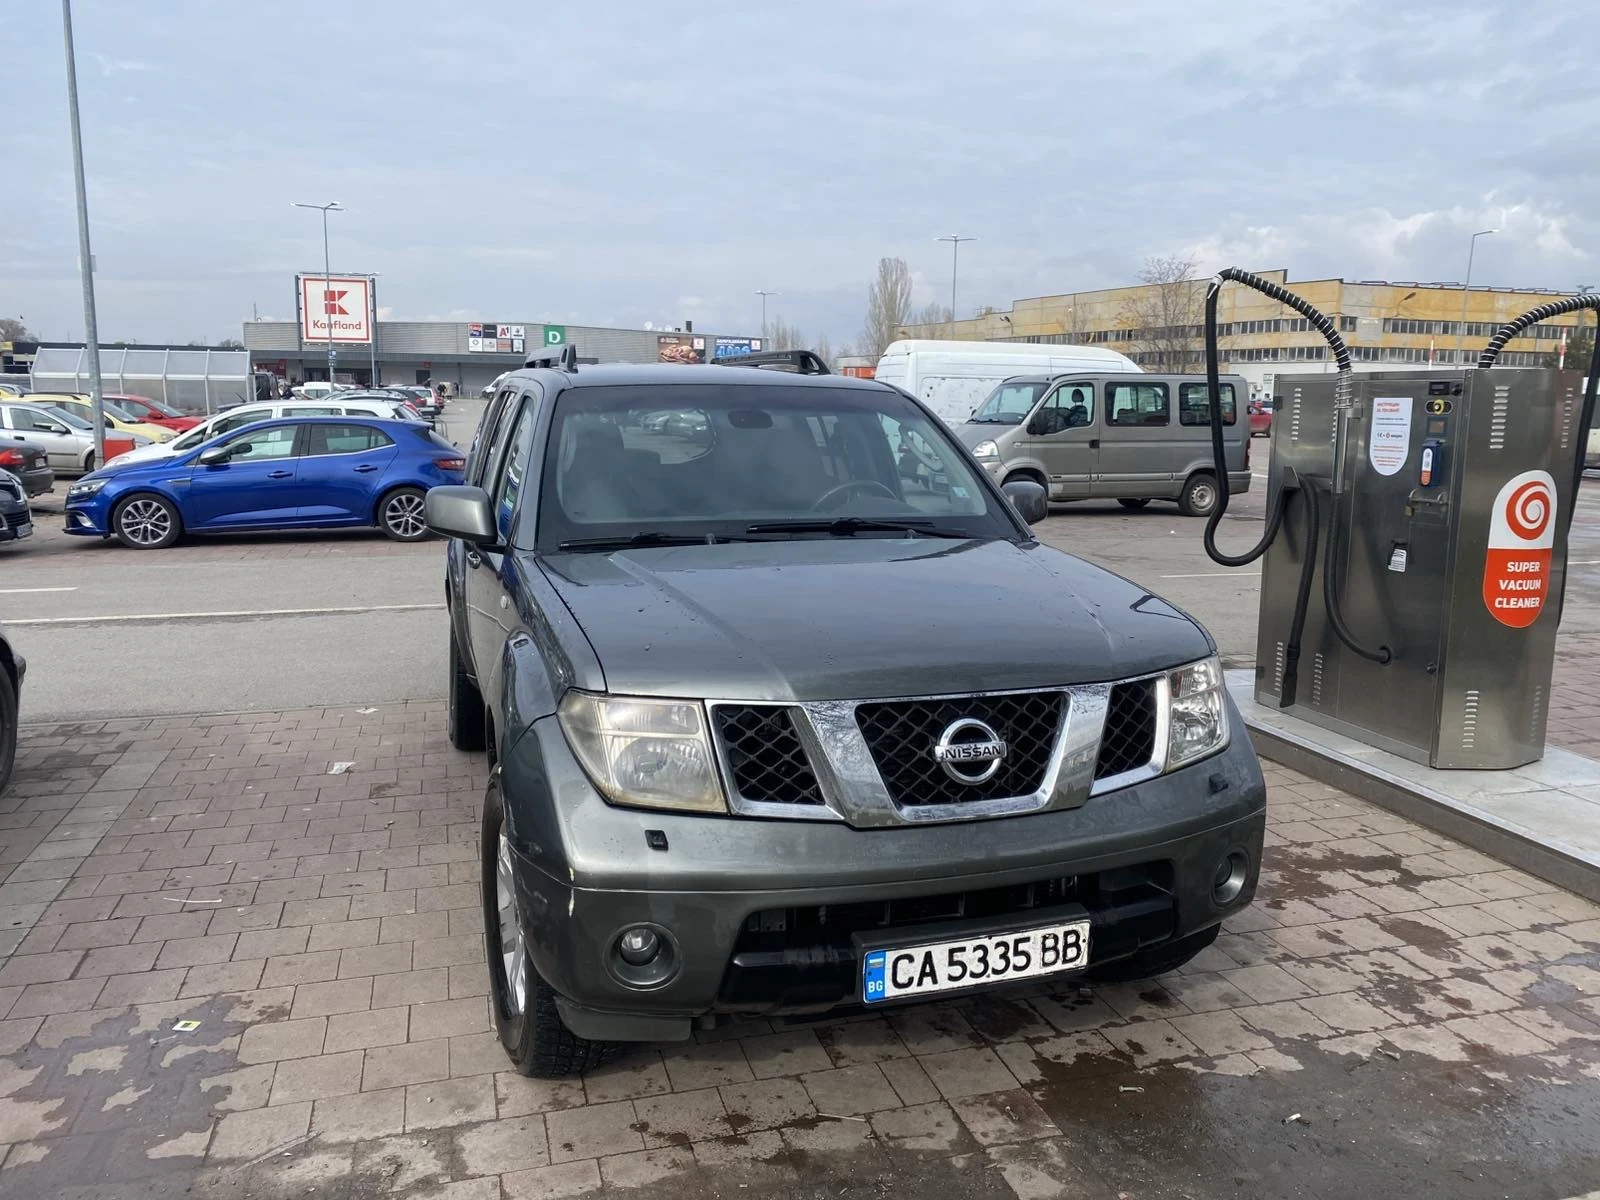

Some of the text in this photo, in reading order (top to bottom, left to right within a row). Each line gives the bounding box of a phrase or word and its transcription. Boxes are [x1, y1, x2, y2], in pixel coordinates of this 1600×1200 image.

[313, 320, 361, 330] Kaufland
[549, 331, 560, 343] D
[1507, 562, 1540, 572] SUPER
[1499, 580, 1541, 590] VACUUM
[1495, 597, 1540, 608] CLEANER
[945, 745, 1001, 758] NISSAN
[891, 929, 1083, 989] CA 5335 BB
[868, 980, 884, 993] BG
